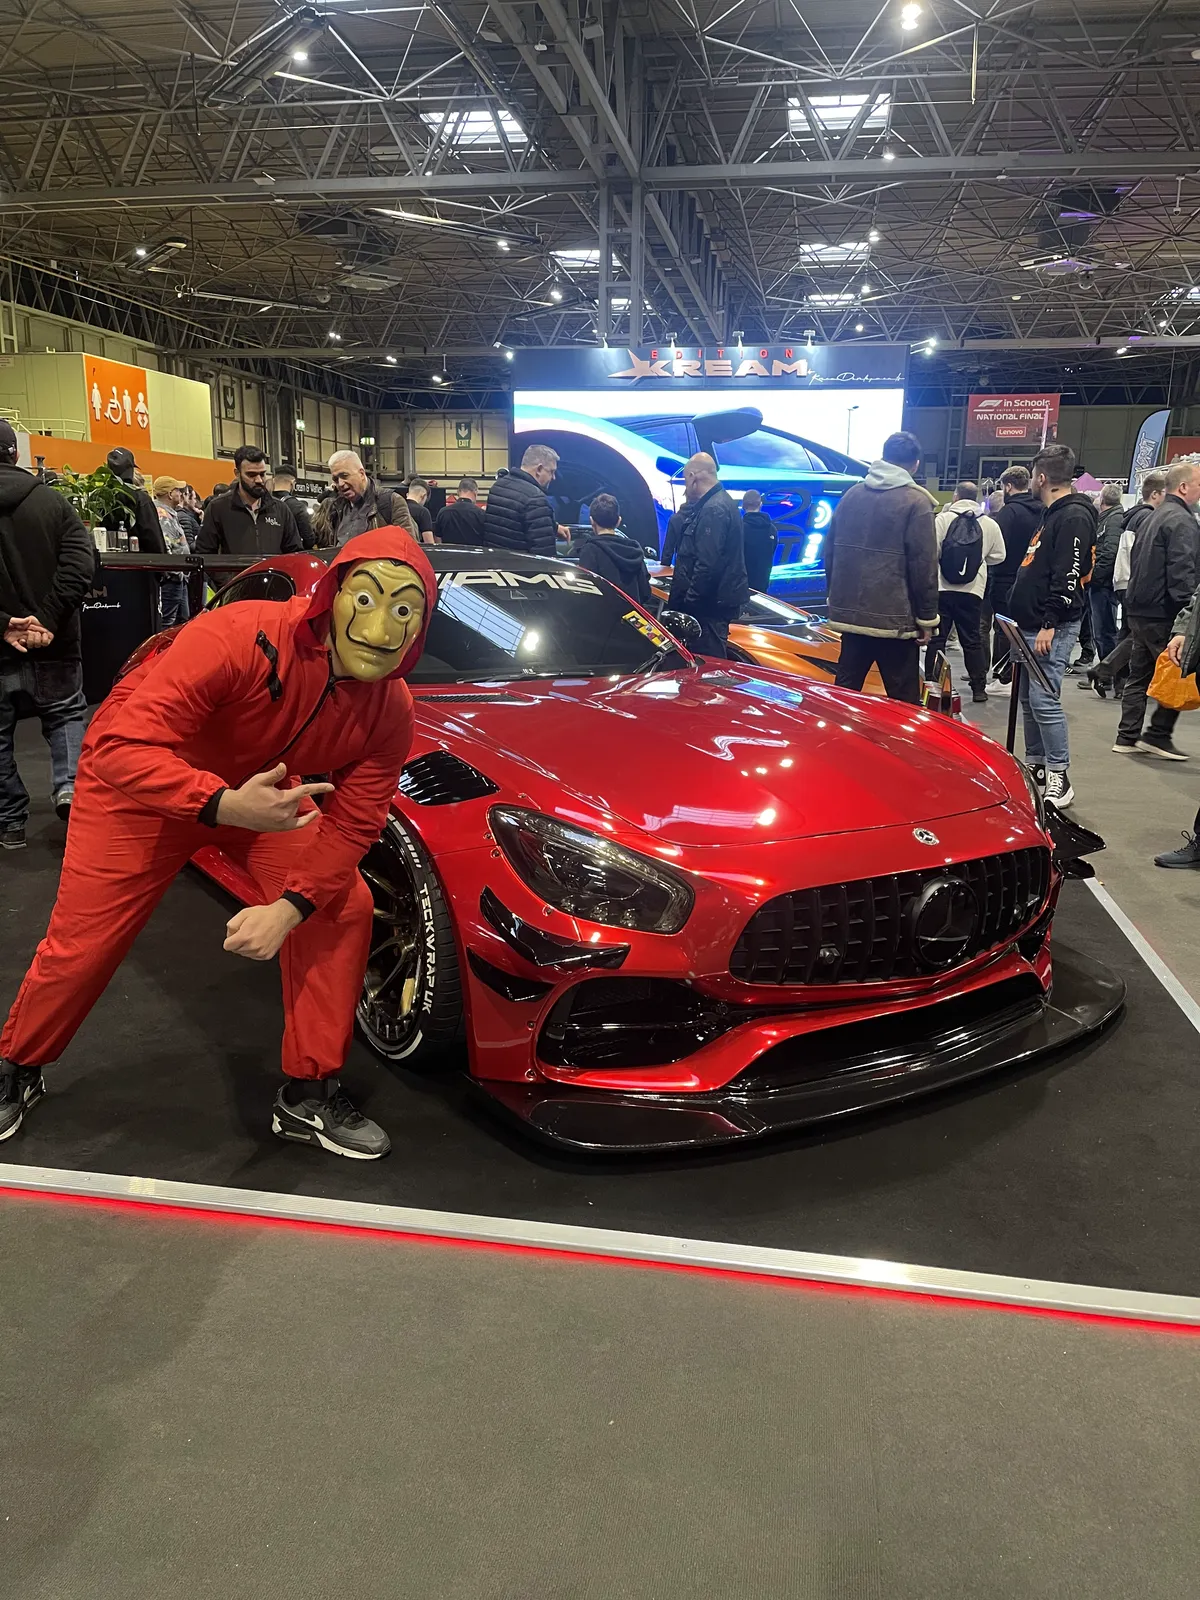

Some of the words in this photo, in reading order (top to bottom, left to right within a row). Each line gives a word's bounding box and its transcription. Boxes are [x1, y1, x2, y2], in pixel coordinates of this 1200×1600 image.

[651, 349, 793, 359] EDITION
[612, 355, 808, 379] KREAM
[1003, 399, 1012, 407] in
[1013, 399, 1051, 407] Schools
[1066, 536, 1081, 577] LIVING
[1067, 579, 1077, 591] TO
[419, 882, 437, 988] TECKWRAP
[421, 990, 434, 1015] UK
